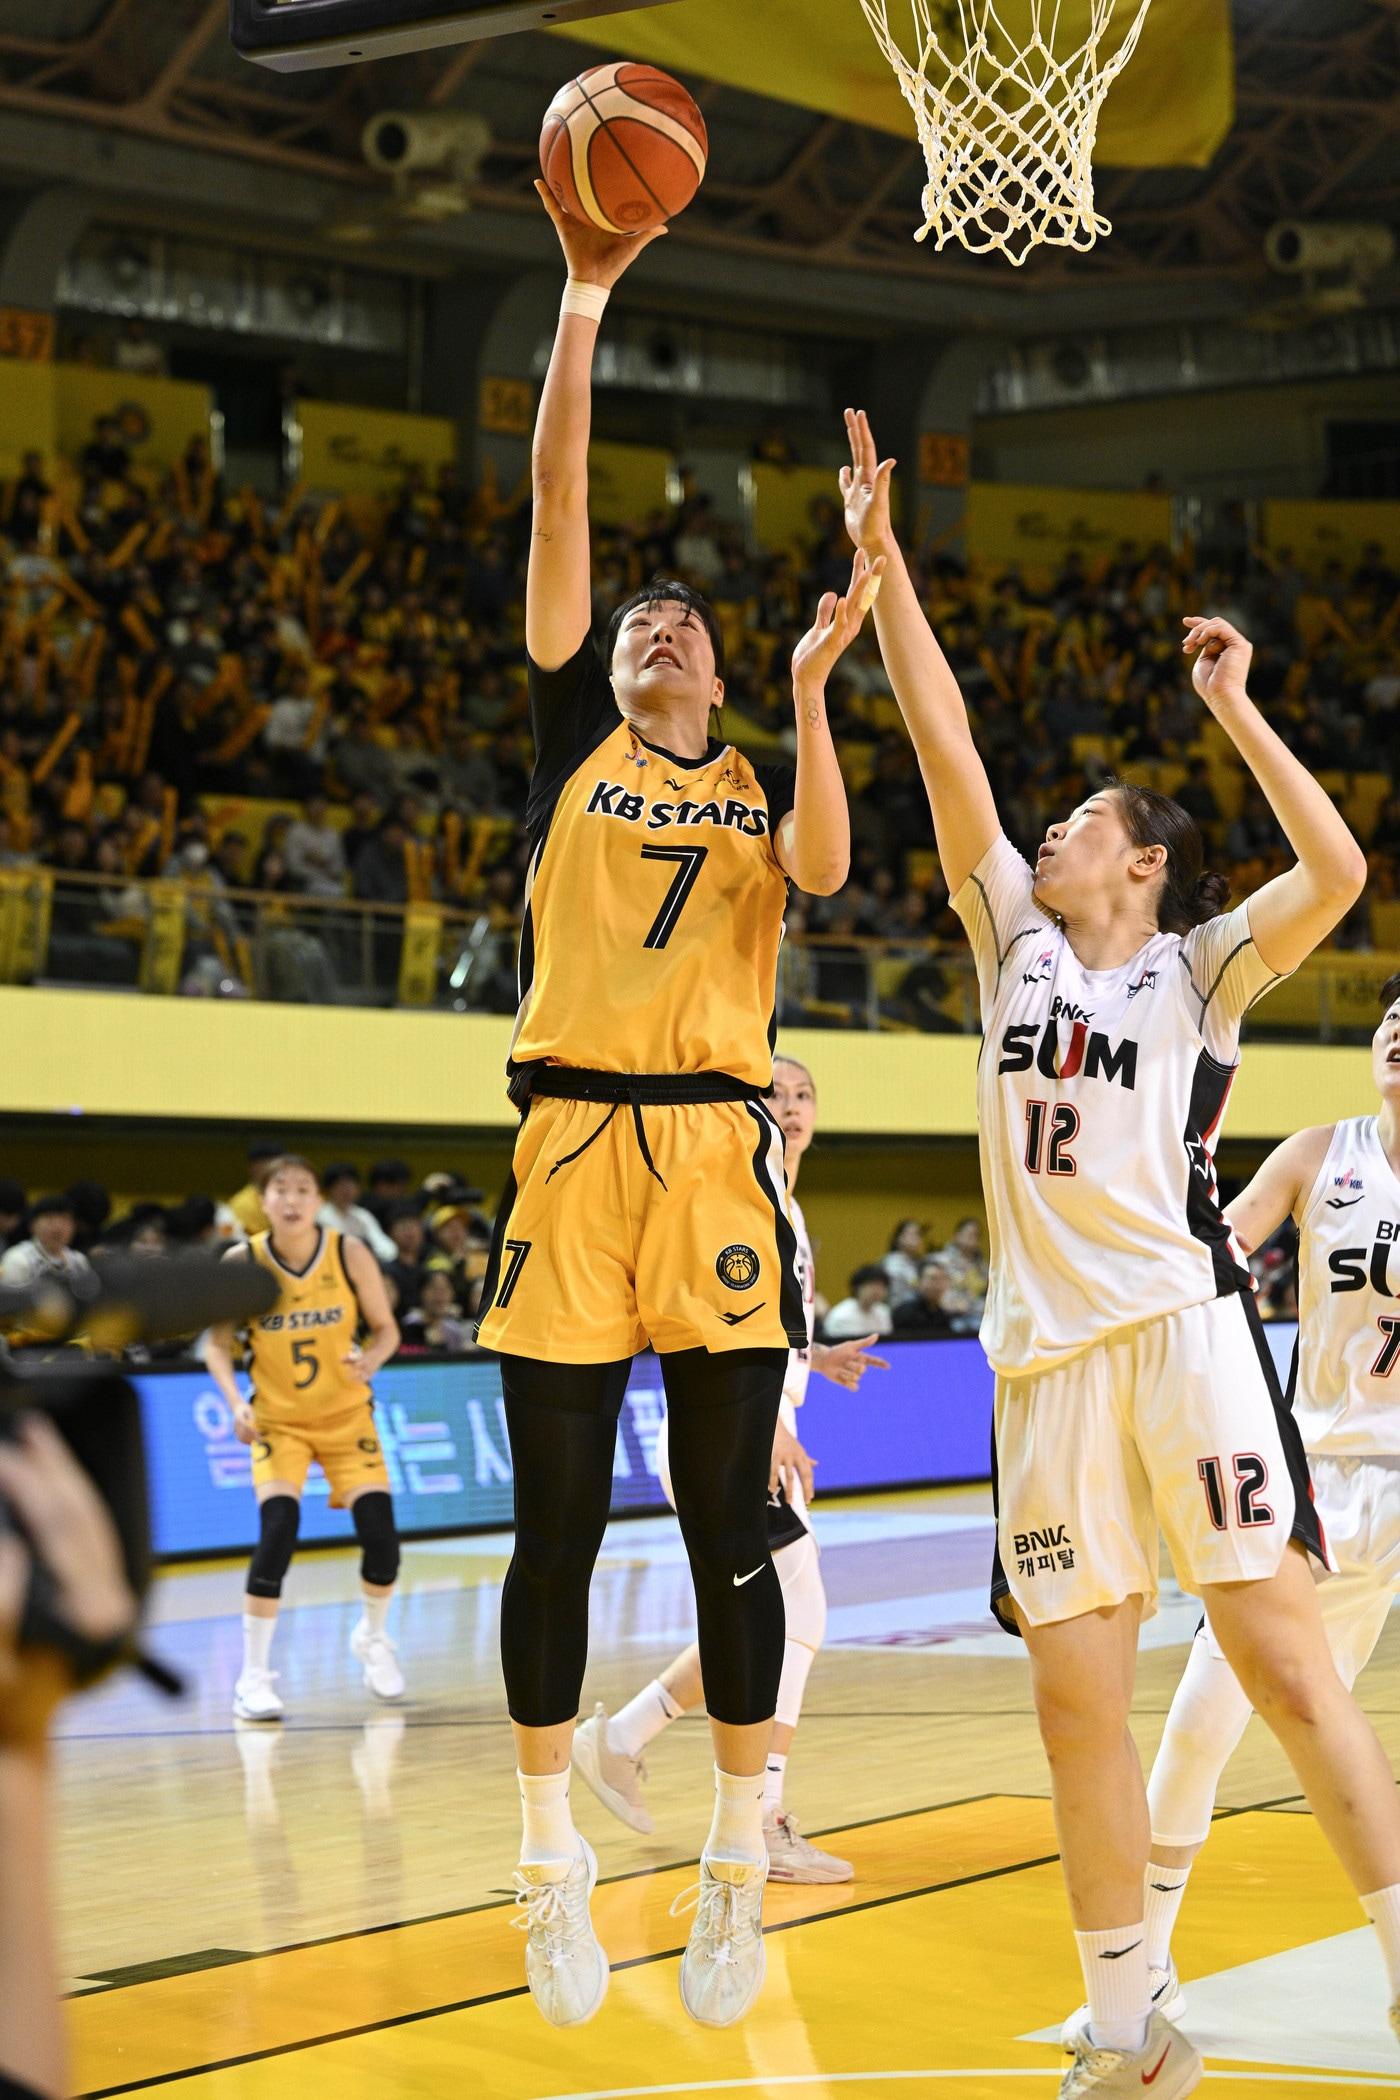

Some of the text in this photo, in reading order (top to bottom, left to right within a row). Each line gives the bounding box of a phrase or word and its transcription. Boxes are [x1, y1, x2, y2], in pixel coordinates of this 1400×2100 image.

[586, 780, 769, 838] KB STARS
[640, 843, 710, 950] 7
[1050, 995, 1097, 1024] BNK
[998, 1018, 1139, 1091] SUM
[1024, 1099, 1081, 1177] 12
[495, 1239, 533, 1309] 7
[259, 1307, 345, 1331] KB STARS
[1370, 1315, 1400, 1378] 7
[291, 1338, 320, 1390] 5
[1197, 1452, 1275, 1531] 12
[1013, 1524, 1072, 1555] BNK
[1017, 1548, 1075, 1578] 캐피탈
